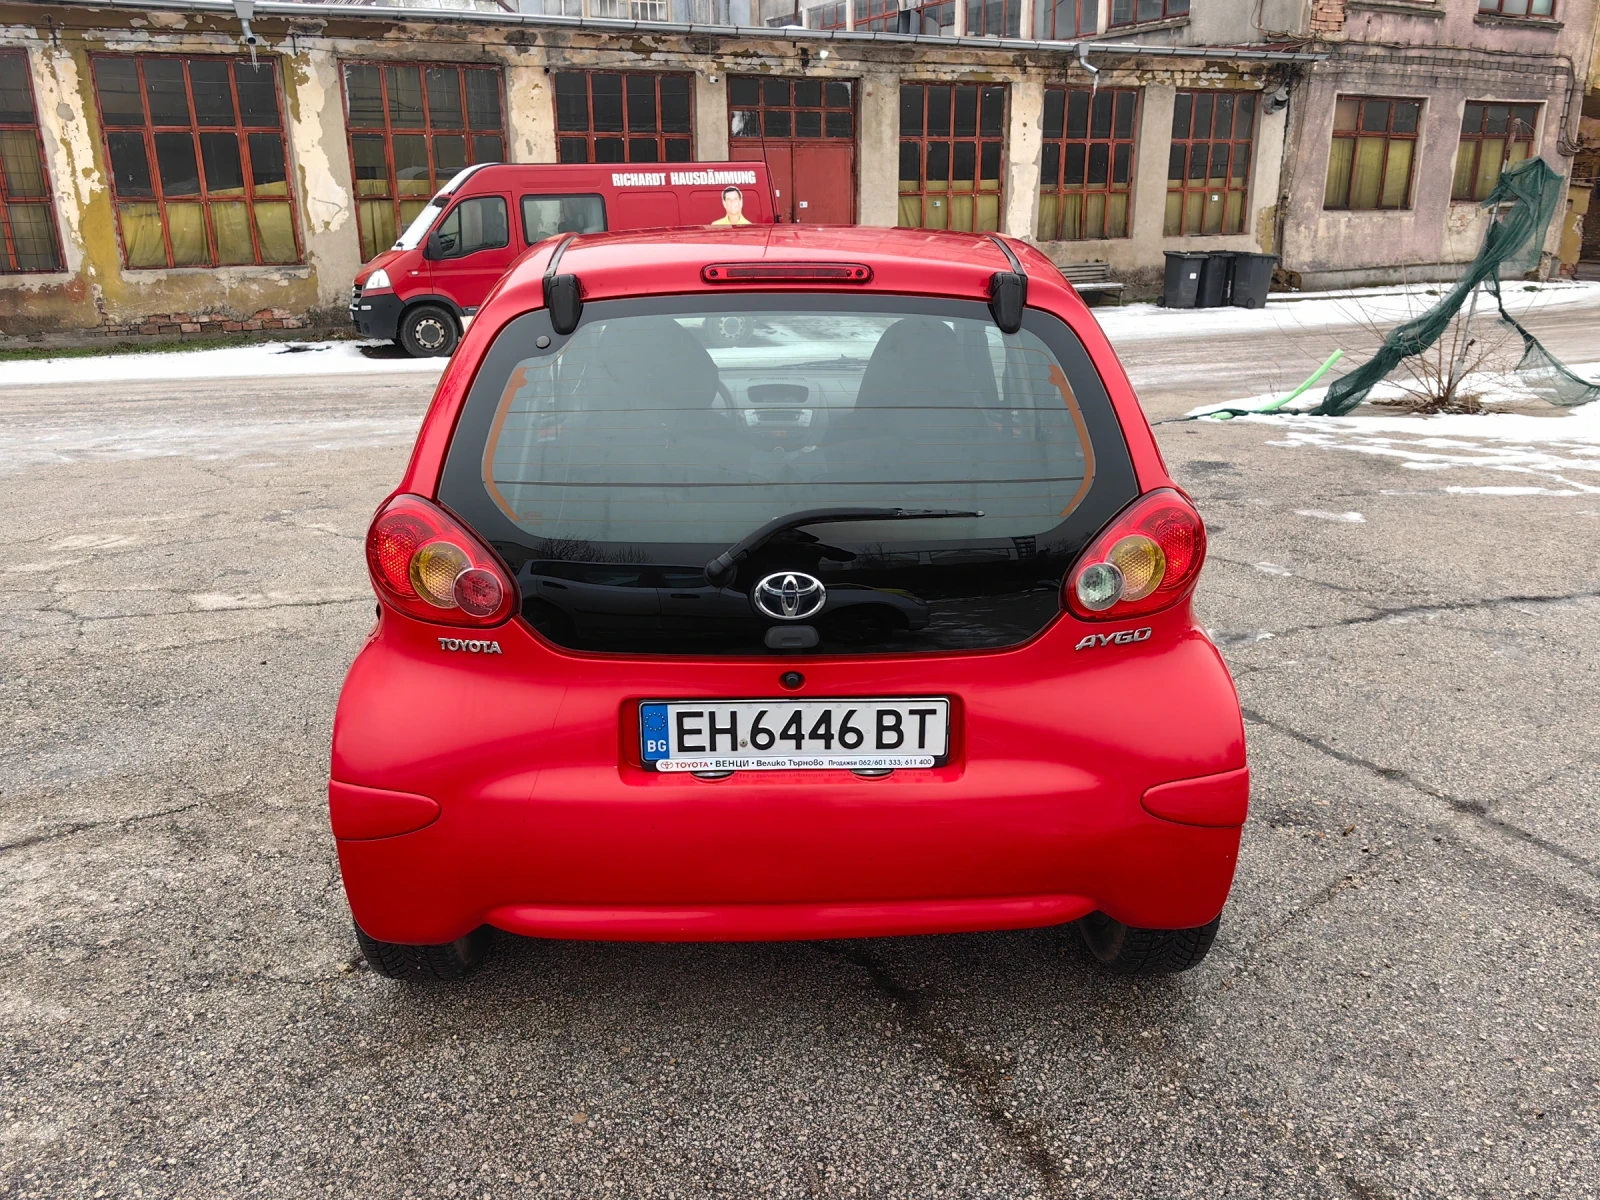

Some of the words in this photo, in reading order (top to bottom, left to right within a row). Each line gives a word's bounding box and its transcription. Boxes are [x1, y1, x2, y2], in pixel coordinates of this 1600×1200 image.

[611, 172, 666, 187] RICHARDT
[670, 169, 756, 185] HAUSDÄMMUNG
[438, 637, 502, 654] TOYOTA
[1075, 627, 1152, 651] AYGO
[676, 711, 738, 752] EH
[750, 709, 864, 750] 6446
[876, 708, 937, 749] BT
[647, 740, 667, 752] BG
[715, 760, 749, 769] ВЕНЦИ
